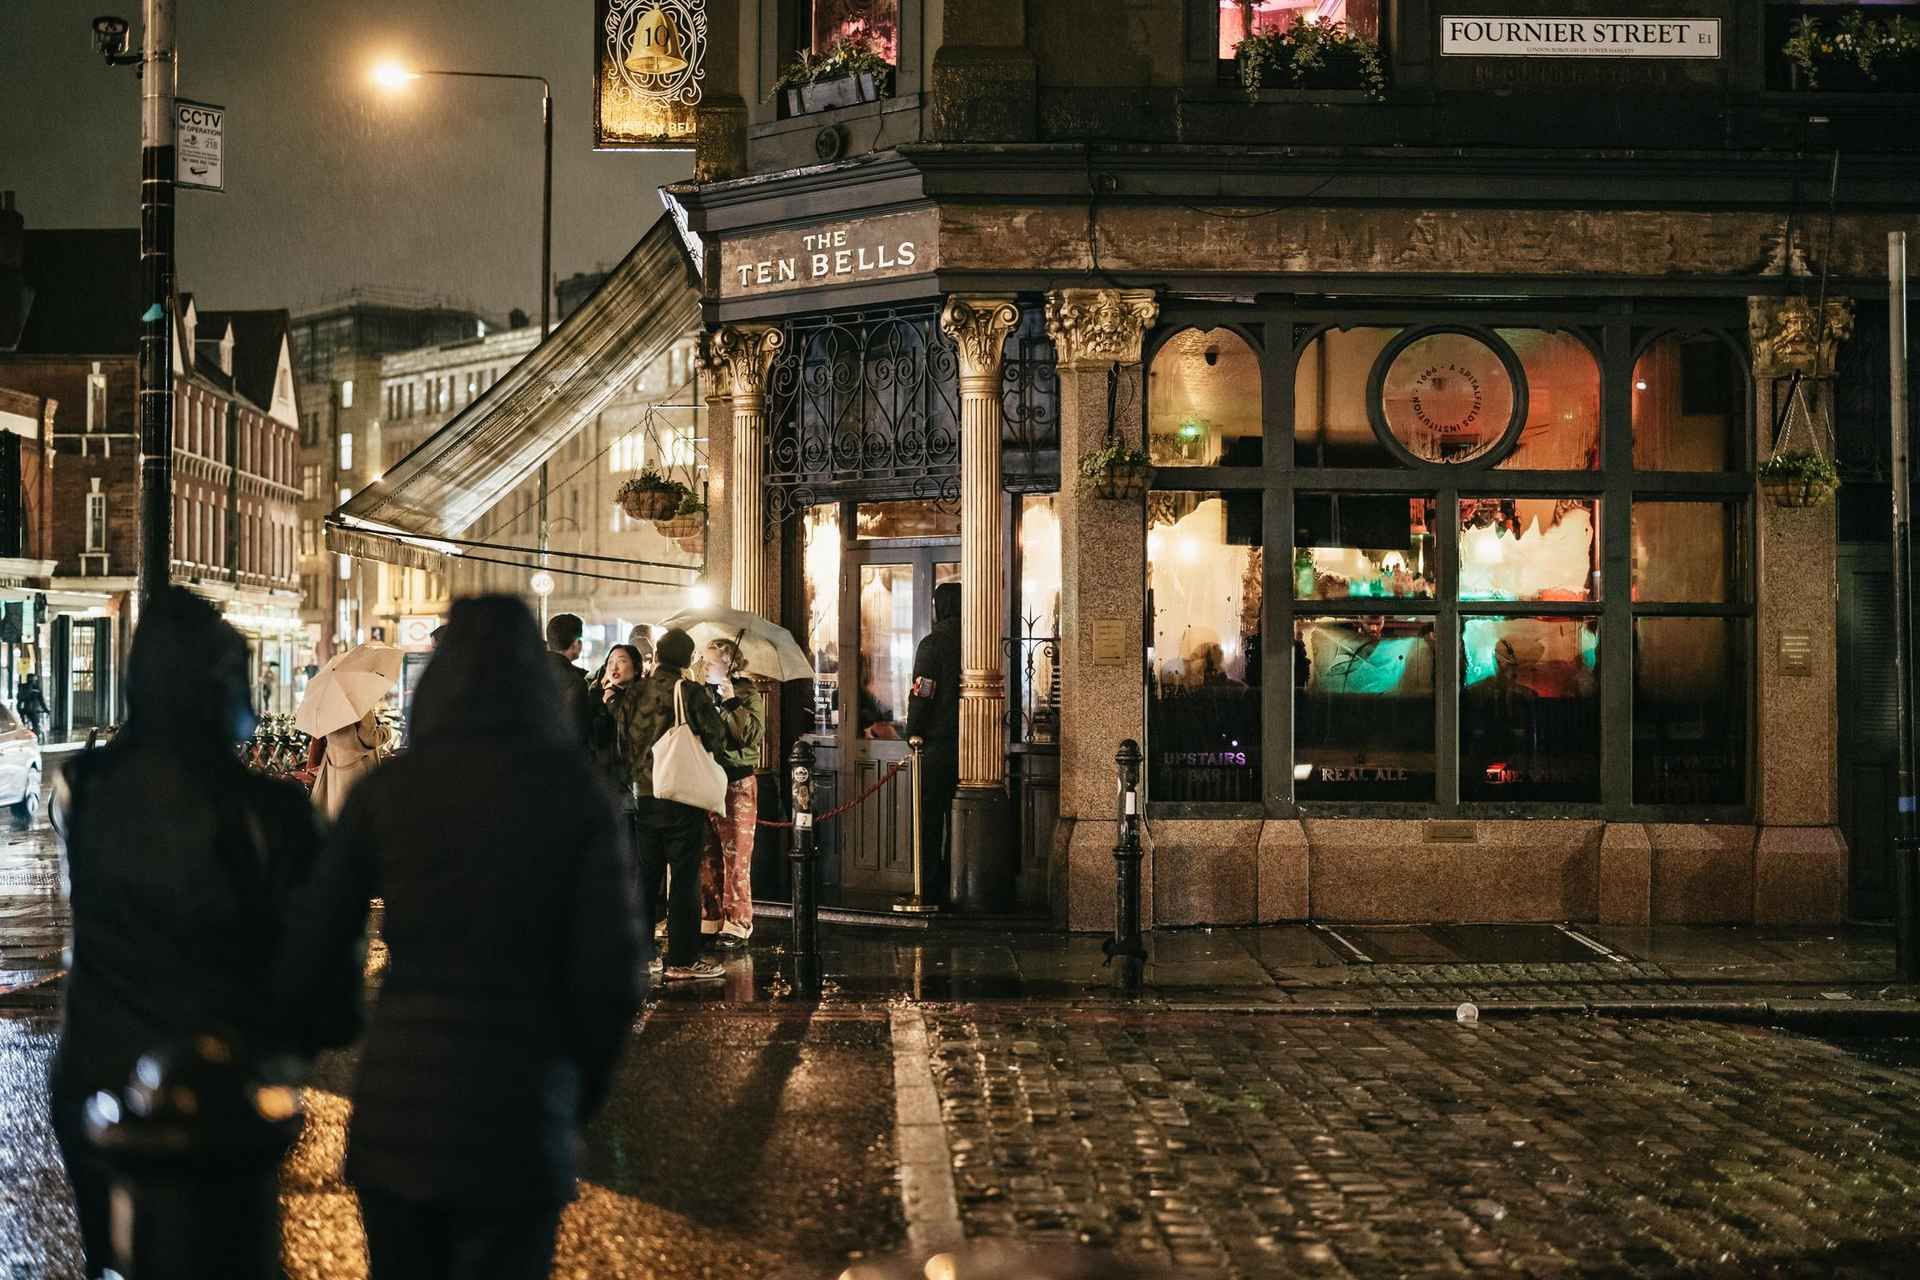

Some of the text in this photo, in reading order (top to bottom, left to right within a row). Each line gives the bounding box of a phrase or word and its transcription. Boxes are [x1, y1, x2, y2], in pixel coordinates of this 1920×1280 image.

[644, 24, 669, 48] 10
[1450, 21, 1712, 44] FOURNIER STREET E1
[180, 108, 220, 128] CCTV
[186, 125, 222, 136] OPERATION
[802, 230, 847, 251] THE
[736, 241, 916, 287] TEN BELLS
[1459, 367, 1482, 427] SPITALFIELDS
[1411, 396, 1462, 433] INSTITUTION
[1163, 752, 1247, 766] UPSTAIRS
[1321, 767, 1408, 781] REAL ALE
